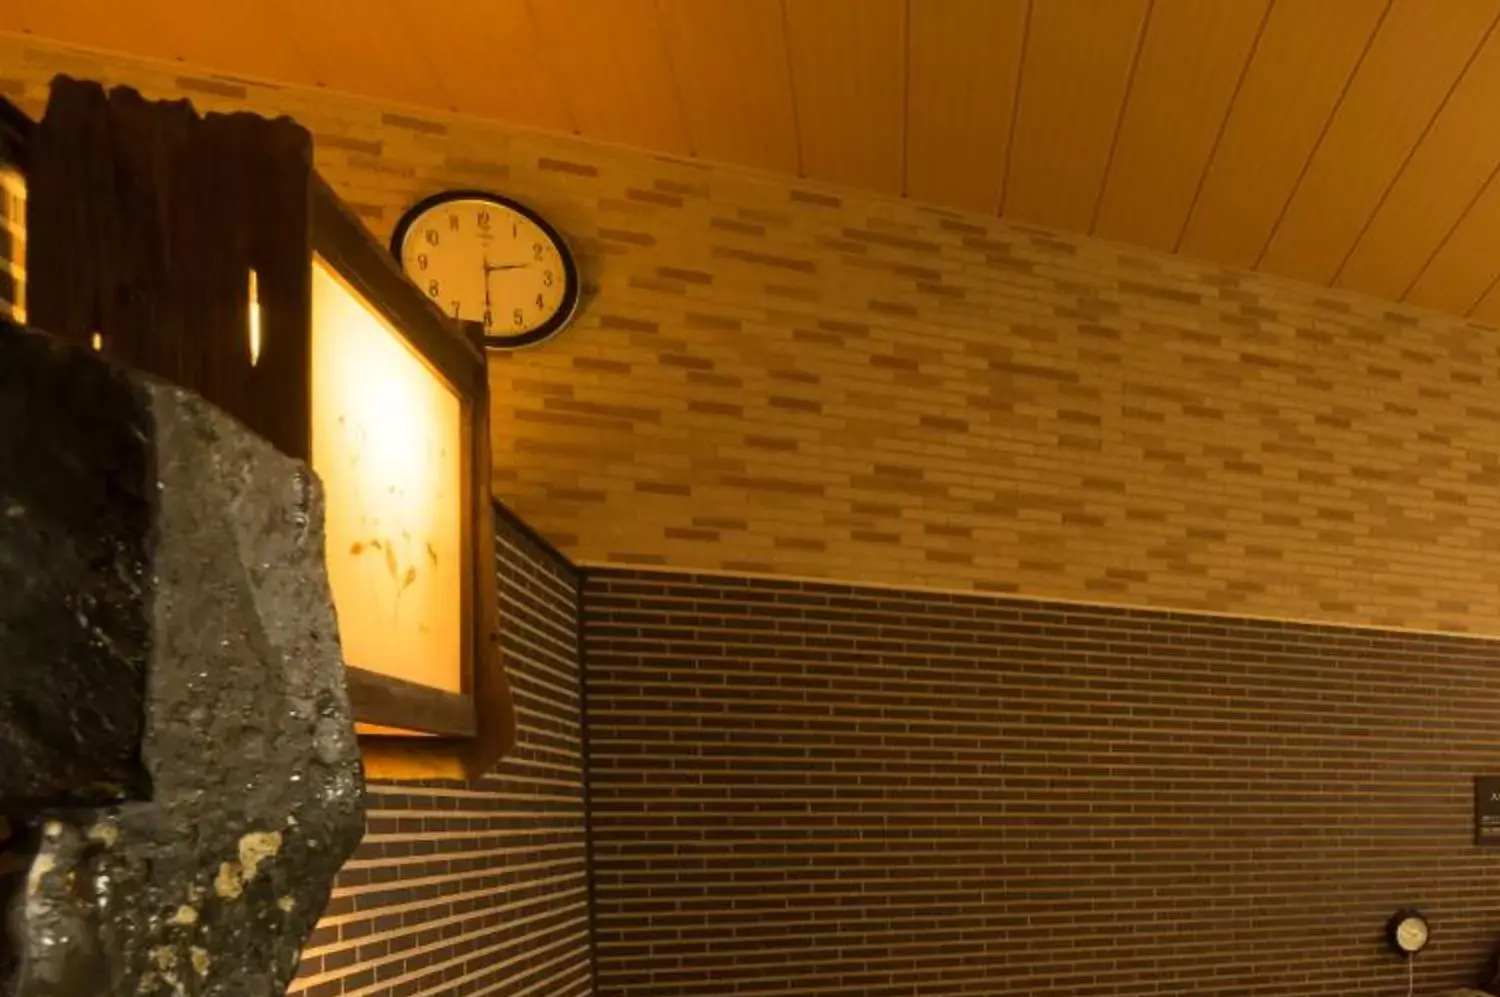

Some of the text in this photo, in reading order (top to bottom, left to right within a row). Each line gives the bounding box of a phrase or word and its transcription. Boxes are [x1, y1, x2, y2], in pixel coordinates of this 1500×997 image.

[477, 211, 492, 231] 12
[425, 229, 439, 247] 10
[532, 243, 544, 261] 2
[417, 254, 428, 271] 9
[543, 270, 553, 287] 3
[429, 280, 439, 297] 8
[536, 293, 545, 311] 4
